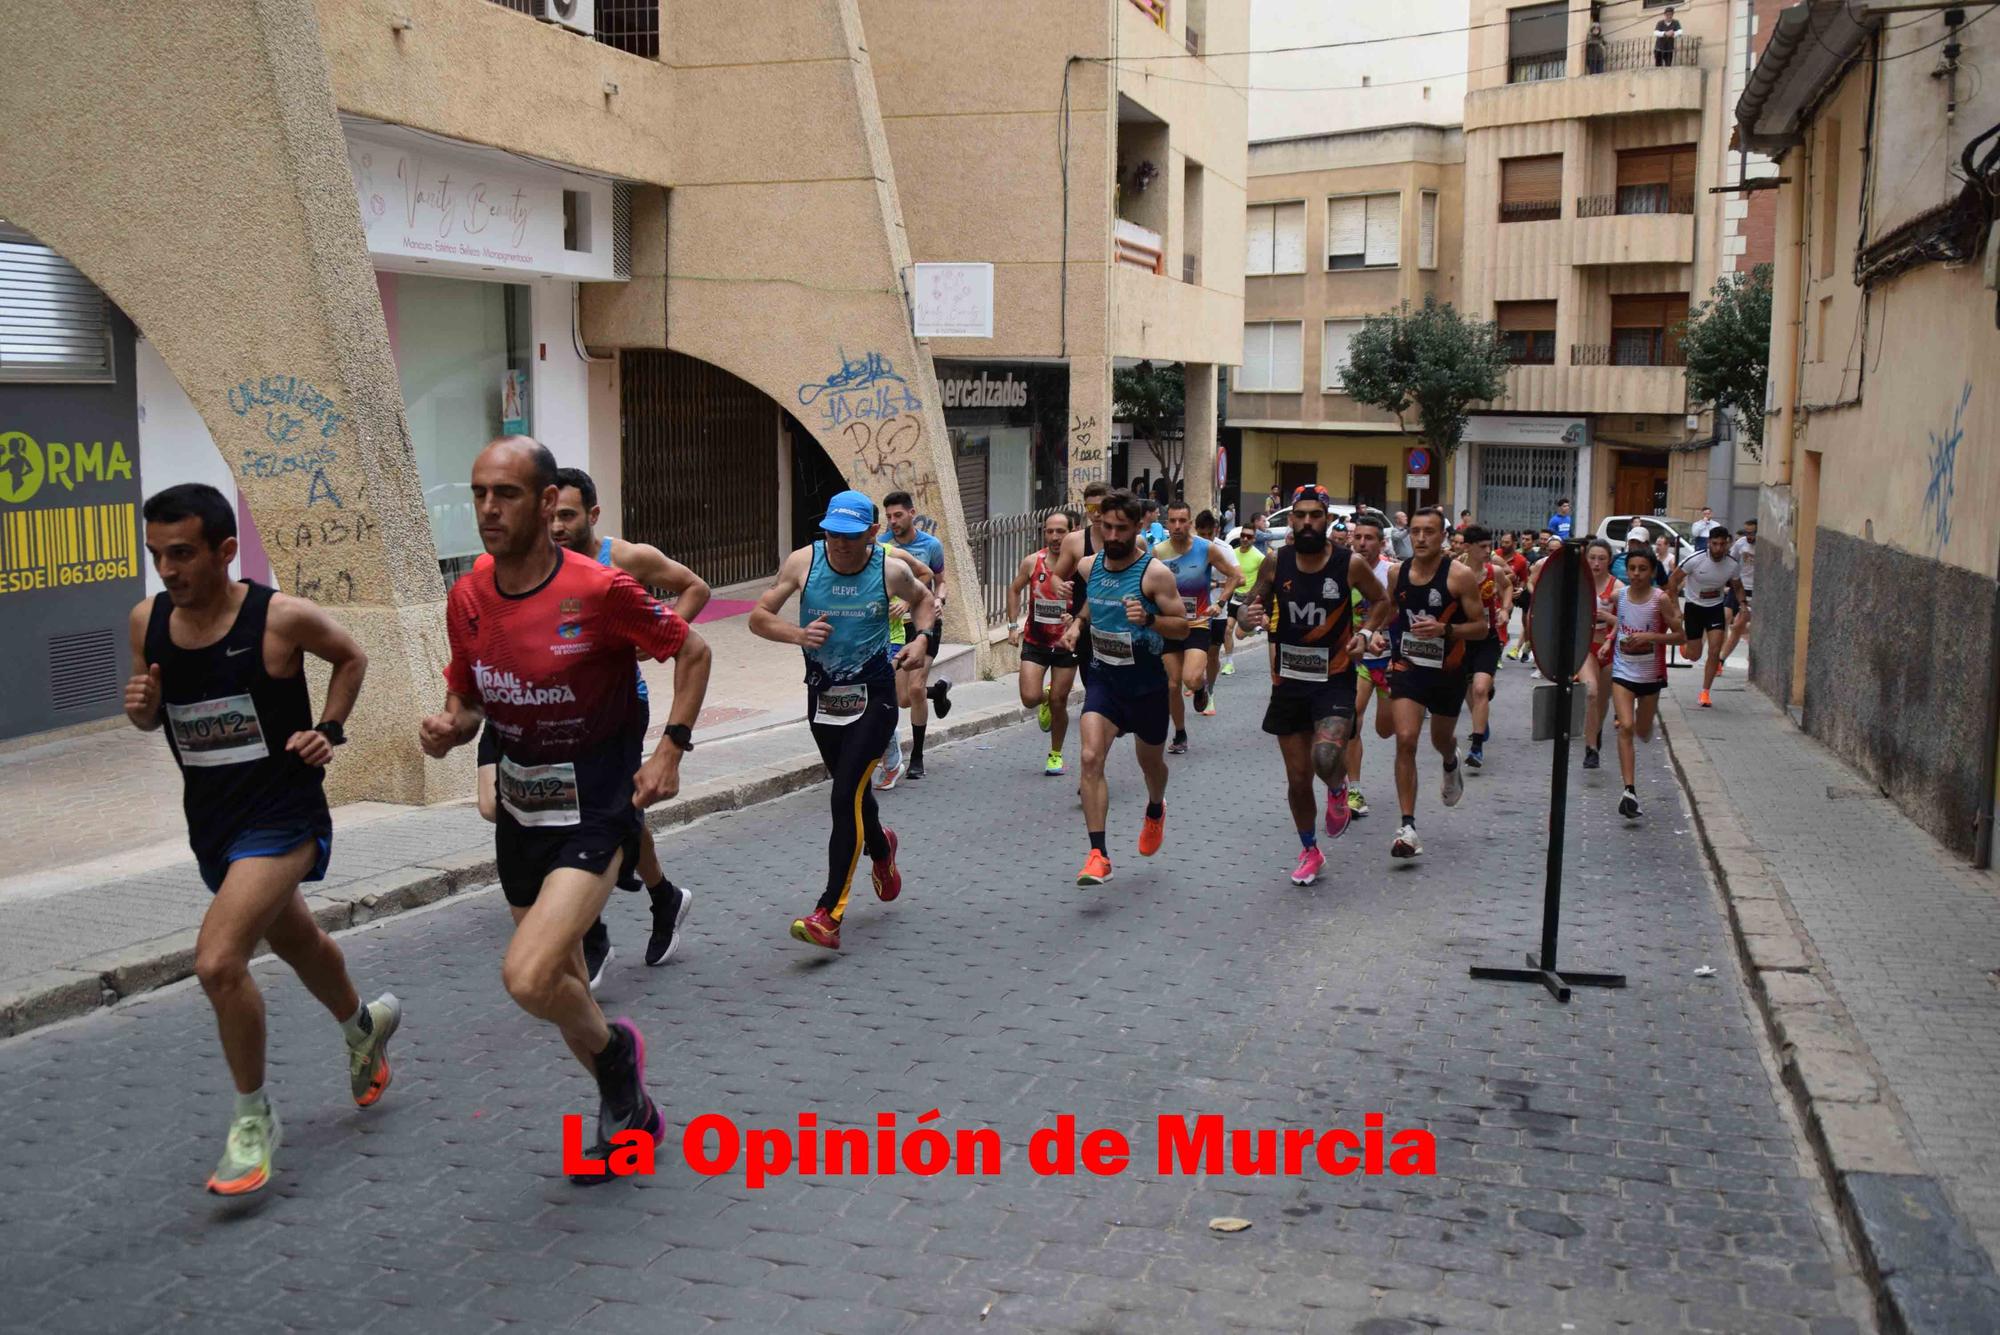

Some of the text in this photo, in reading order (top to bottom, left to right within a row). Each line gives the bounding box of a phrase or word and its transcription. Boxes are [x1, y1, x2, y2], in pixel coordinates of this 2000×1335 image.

[398, 156, 533, 249] Vanity Beauty
[59, 560, 129, 586] 061096
[179, 711, 249, 740] 1012
